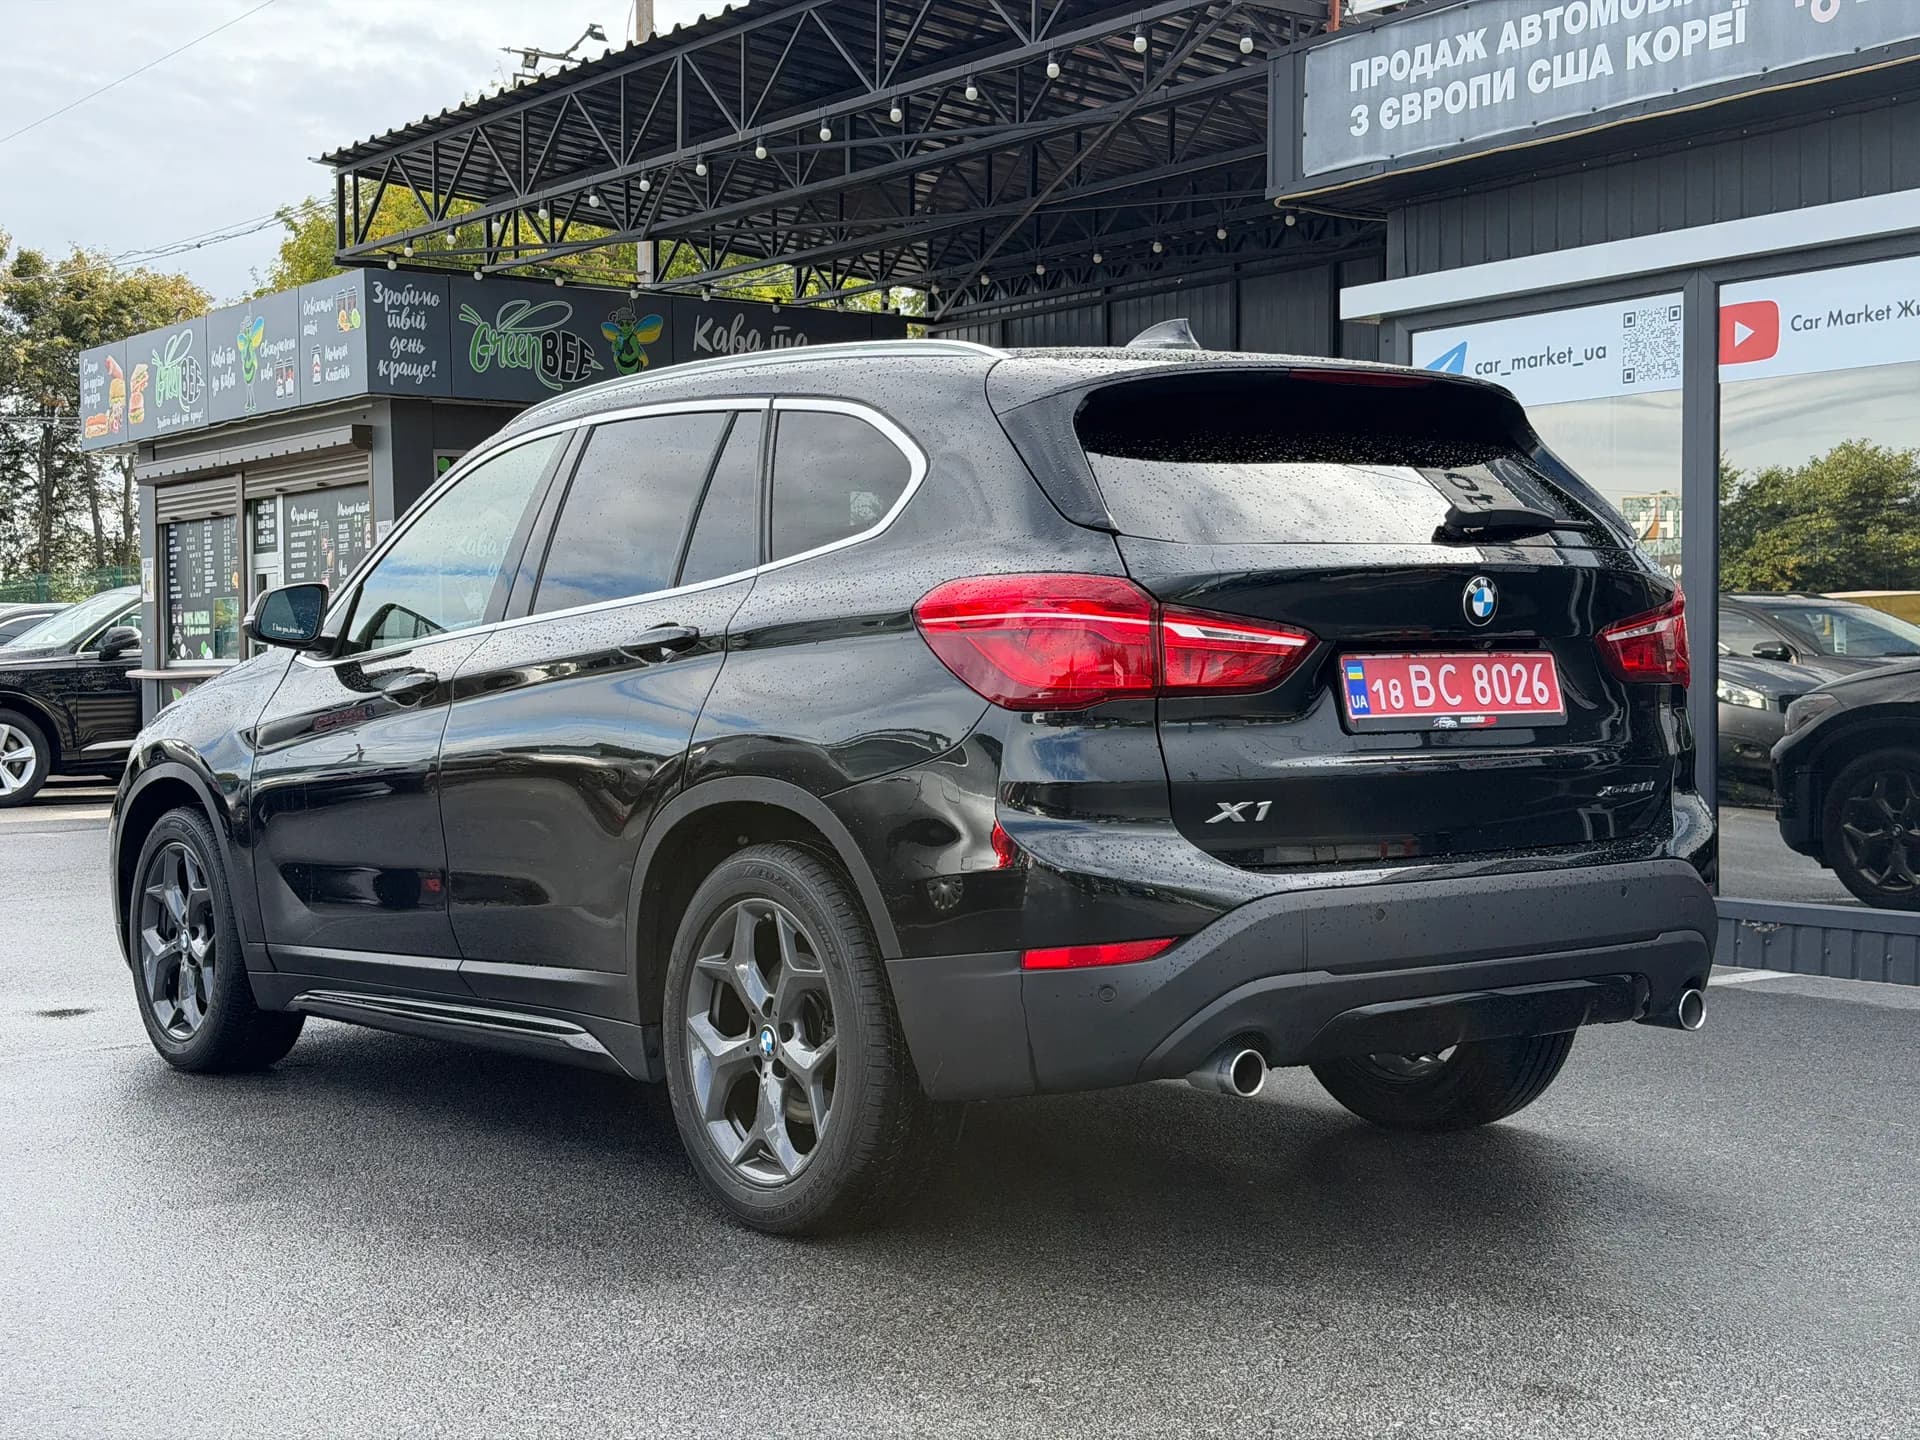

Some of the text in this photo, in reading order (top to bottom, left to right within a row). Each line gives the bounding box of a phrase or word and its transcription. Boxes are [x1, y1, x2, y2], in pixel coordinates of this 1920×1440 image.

[1350, 0, 1697, 92] ПРОДАЖ АВТОМО
[1350, 105, 1369, 137] З
[1379, 67, 1515, 130] ЄВРОПИ
[1528, 44, 1614, 94] США
[1626, 0, 1749, 70] КОРЕЇ
[373, 281, 440, 312] Зробимо
[387, 306, 427, 330] твій
[1790, 314, 1822, 332] Car
[1827, 304, 1892, 328] Market
[390, 336, 425, 359] день
[693, 313, 765, 355] Кава
[377, 359, 437, 385] краще!
[1475, 345, 1607, 376] car_market_ua
[1351, 663, 1550, 710] UA 18 BC 8026
[1205, 800, 1272, 823] X1
